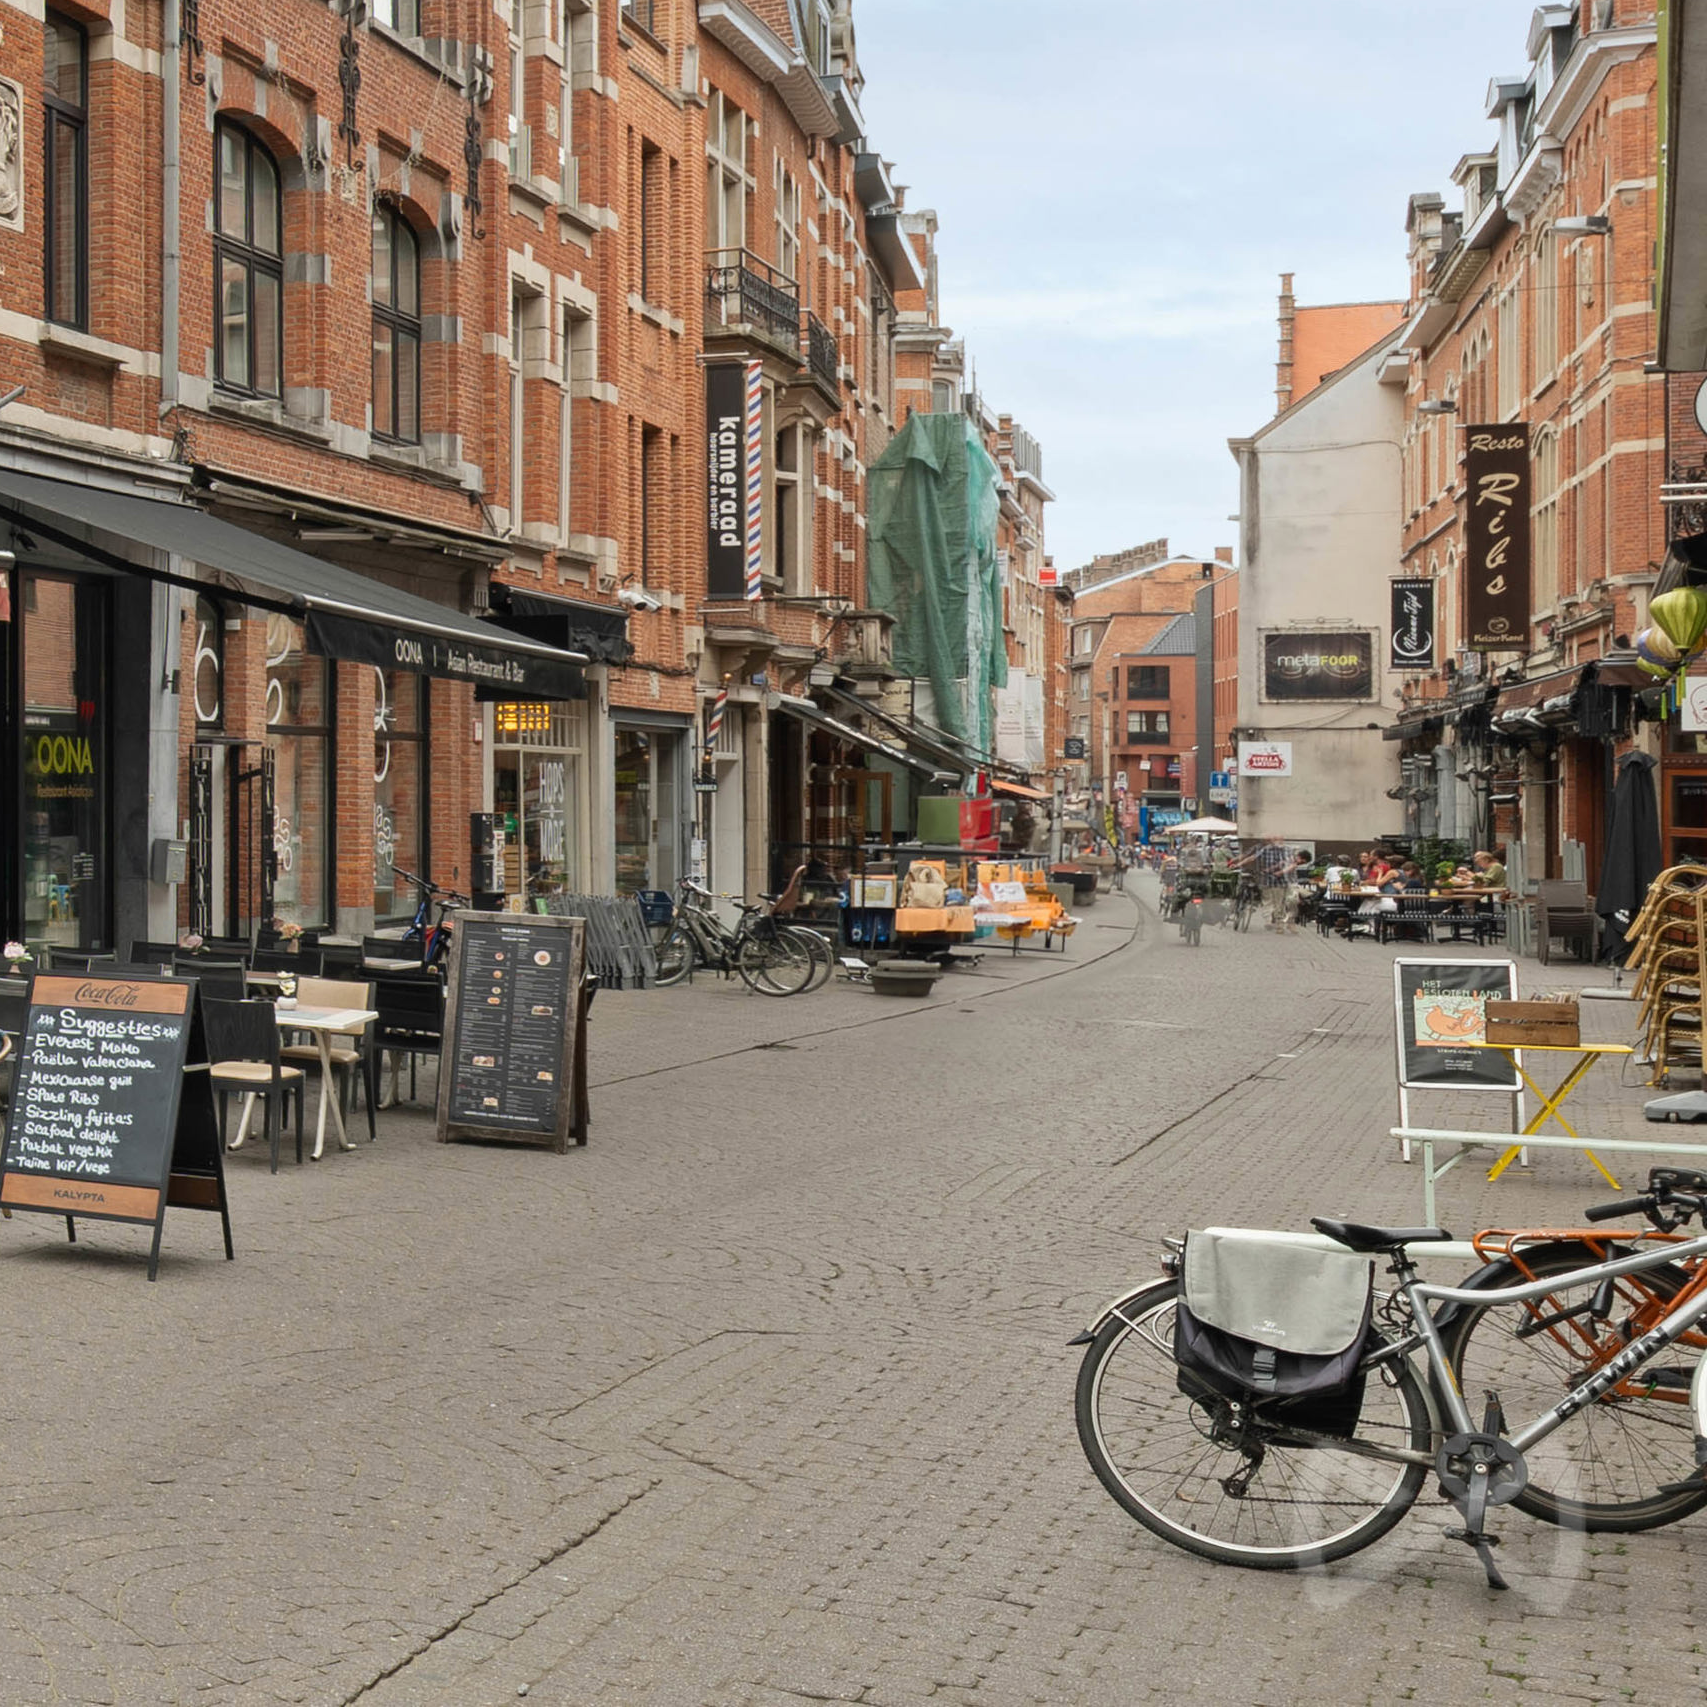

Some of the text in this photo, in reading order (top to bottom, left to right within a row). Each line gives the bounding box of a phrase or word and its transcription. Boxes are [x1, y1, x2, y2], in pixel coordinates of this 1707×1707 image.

[1469, 433, 1526, 453] Resto
[718, 415, 742, 547] kameraad
[1475, 472, 1521, 596] Ribs
[394, 638, 424, 665] OONA
[447, 648, 467, 673] Asian
[467, 651, 505, 681] Restaurant
[512, 661, 526, 684] Bar
[37, 735, 95, 775] OONA
[539, 761, 565, 804] HOPS
[539, 819, 565, 862] MORE
[1422, 979, 1442, 989] HET
[59, 1007, 162, 1037] Suggesties
[79, 1128, 120, 1146] delight
[53, 1189, 106, 1204] KALYPTA
